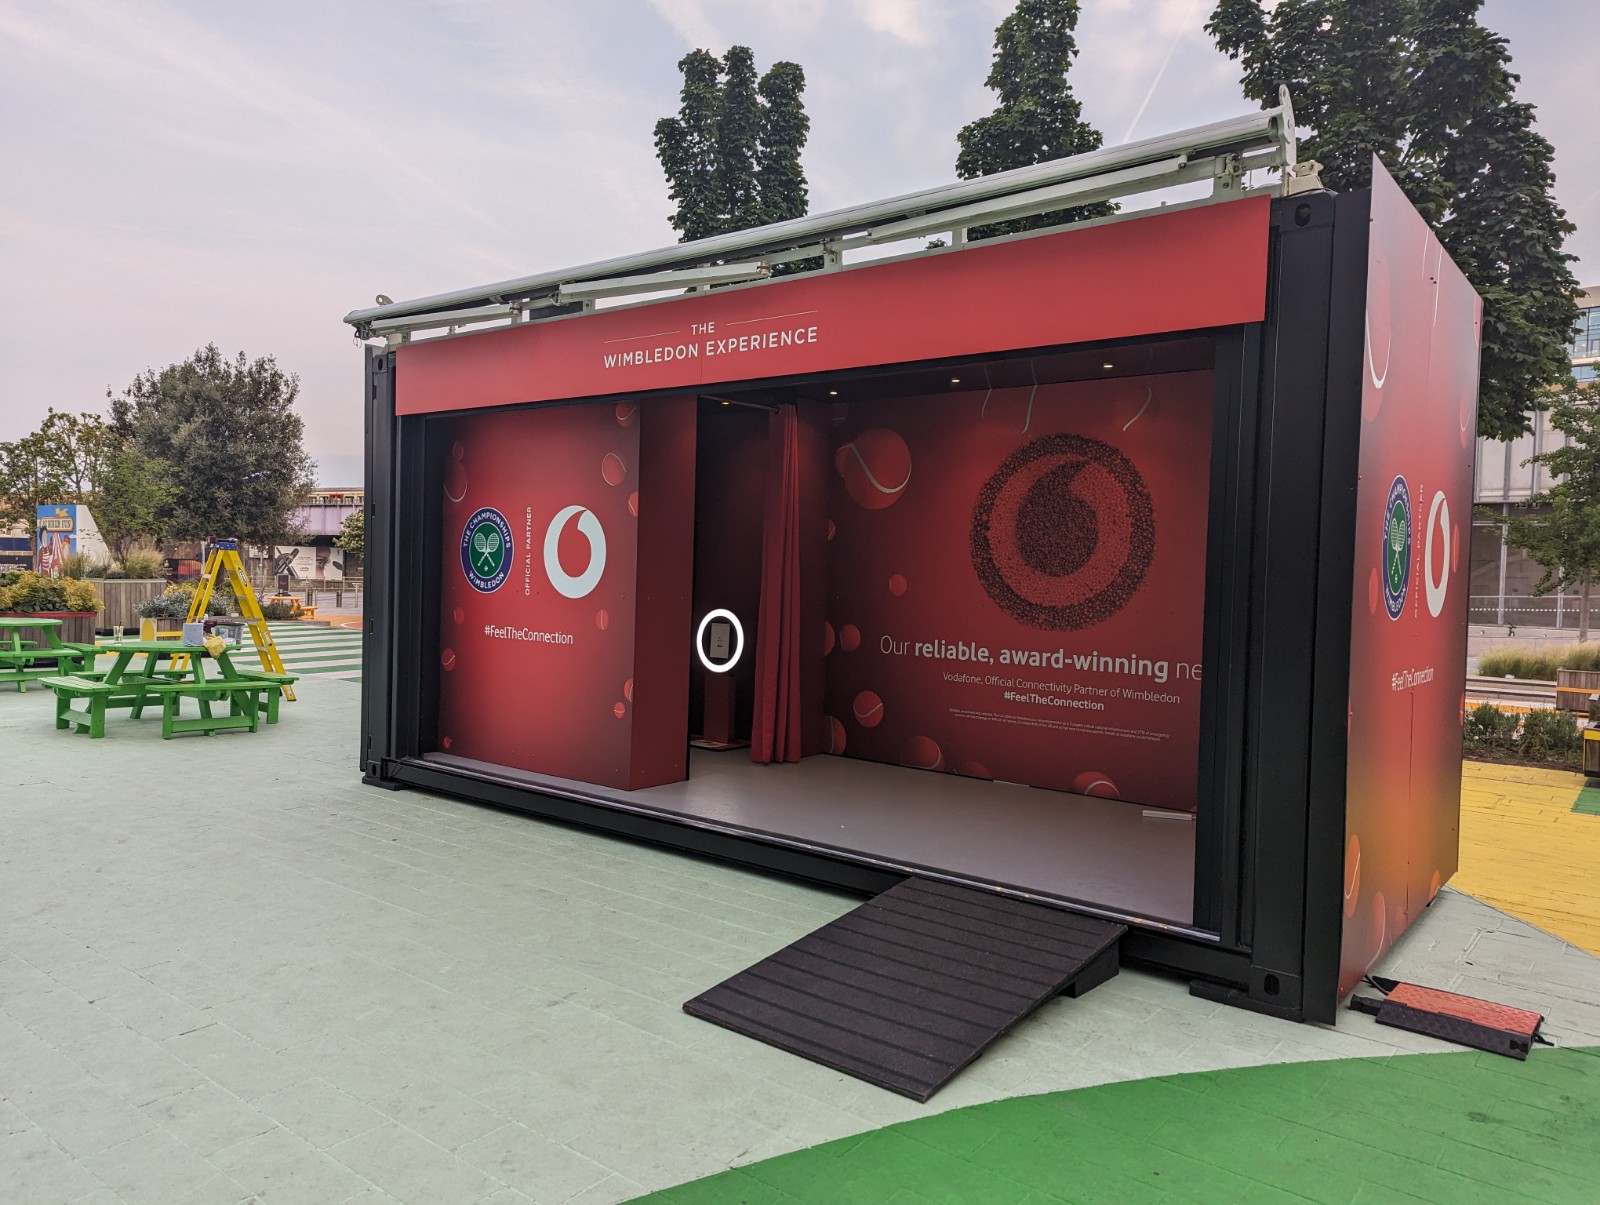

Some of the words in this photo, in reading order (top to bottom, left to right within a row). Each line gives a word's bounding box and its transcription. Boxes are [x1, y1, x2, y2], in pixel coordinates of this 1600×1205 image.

[691, 321, 715, 336] THE
[603, 343, 699, 369] WIMBLEDON
[705, 326, 818, 356] EXPERIENCE
[463, 529, 471, 548] THE
[470, 511, 511, 548] CHAMPIONSHIPS
[469, 570, 505, 589] WIMBLEDON
[484, 624, 574, 645] #FeelTheConnection
[880, 635, 911, 655] Our
[914, 639, 994, 666] reliable,
[999, 648, 1169, 683] award-winning
[942, 671, 984, 686] Vodafone,
[984, 675, 1015, 688] Official
[1016, 678, 1072, 695] Connectivity
[1073, 683, 1108, 697] Partner
[1110, 687, 1121, 698] of
[1122, 688, 1180, 704] Wimbledon
[1003, 690, 1105, 711] #FeelTheConnection
